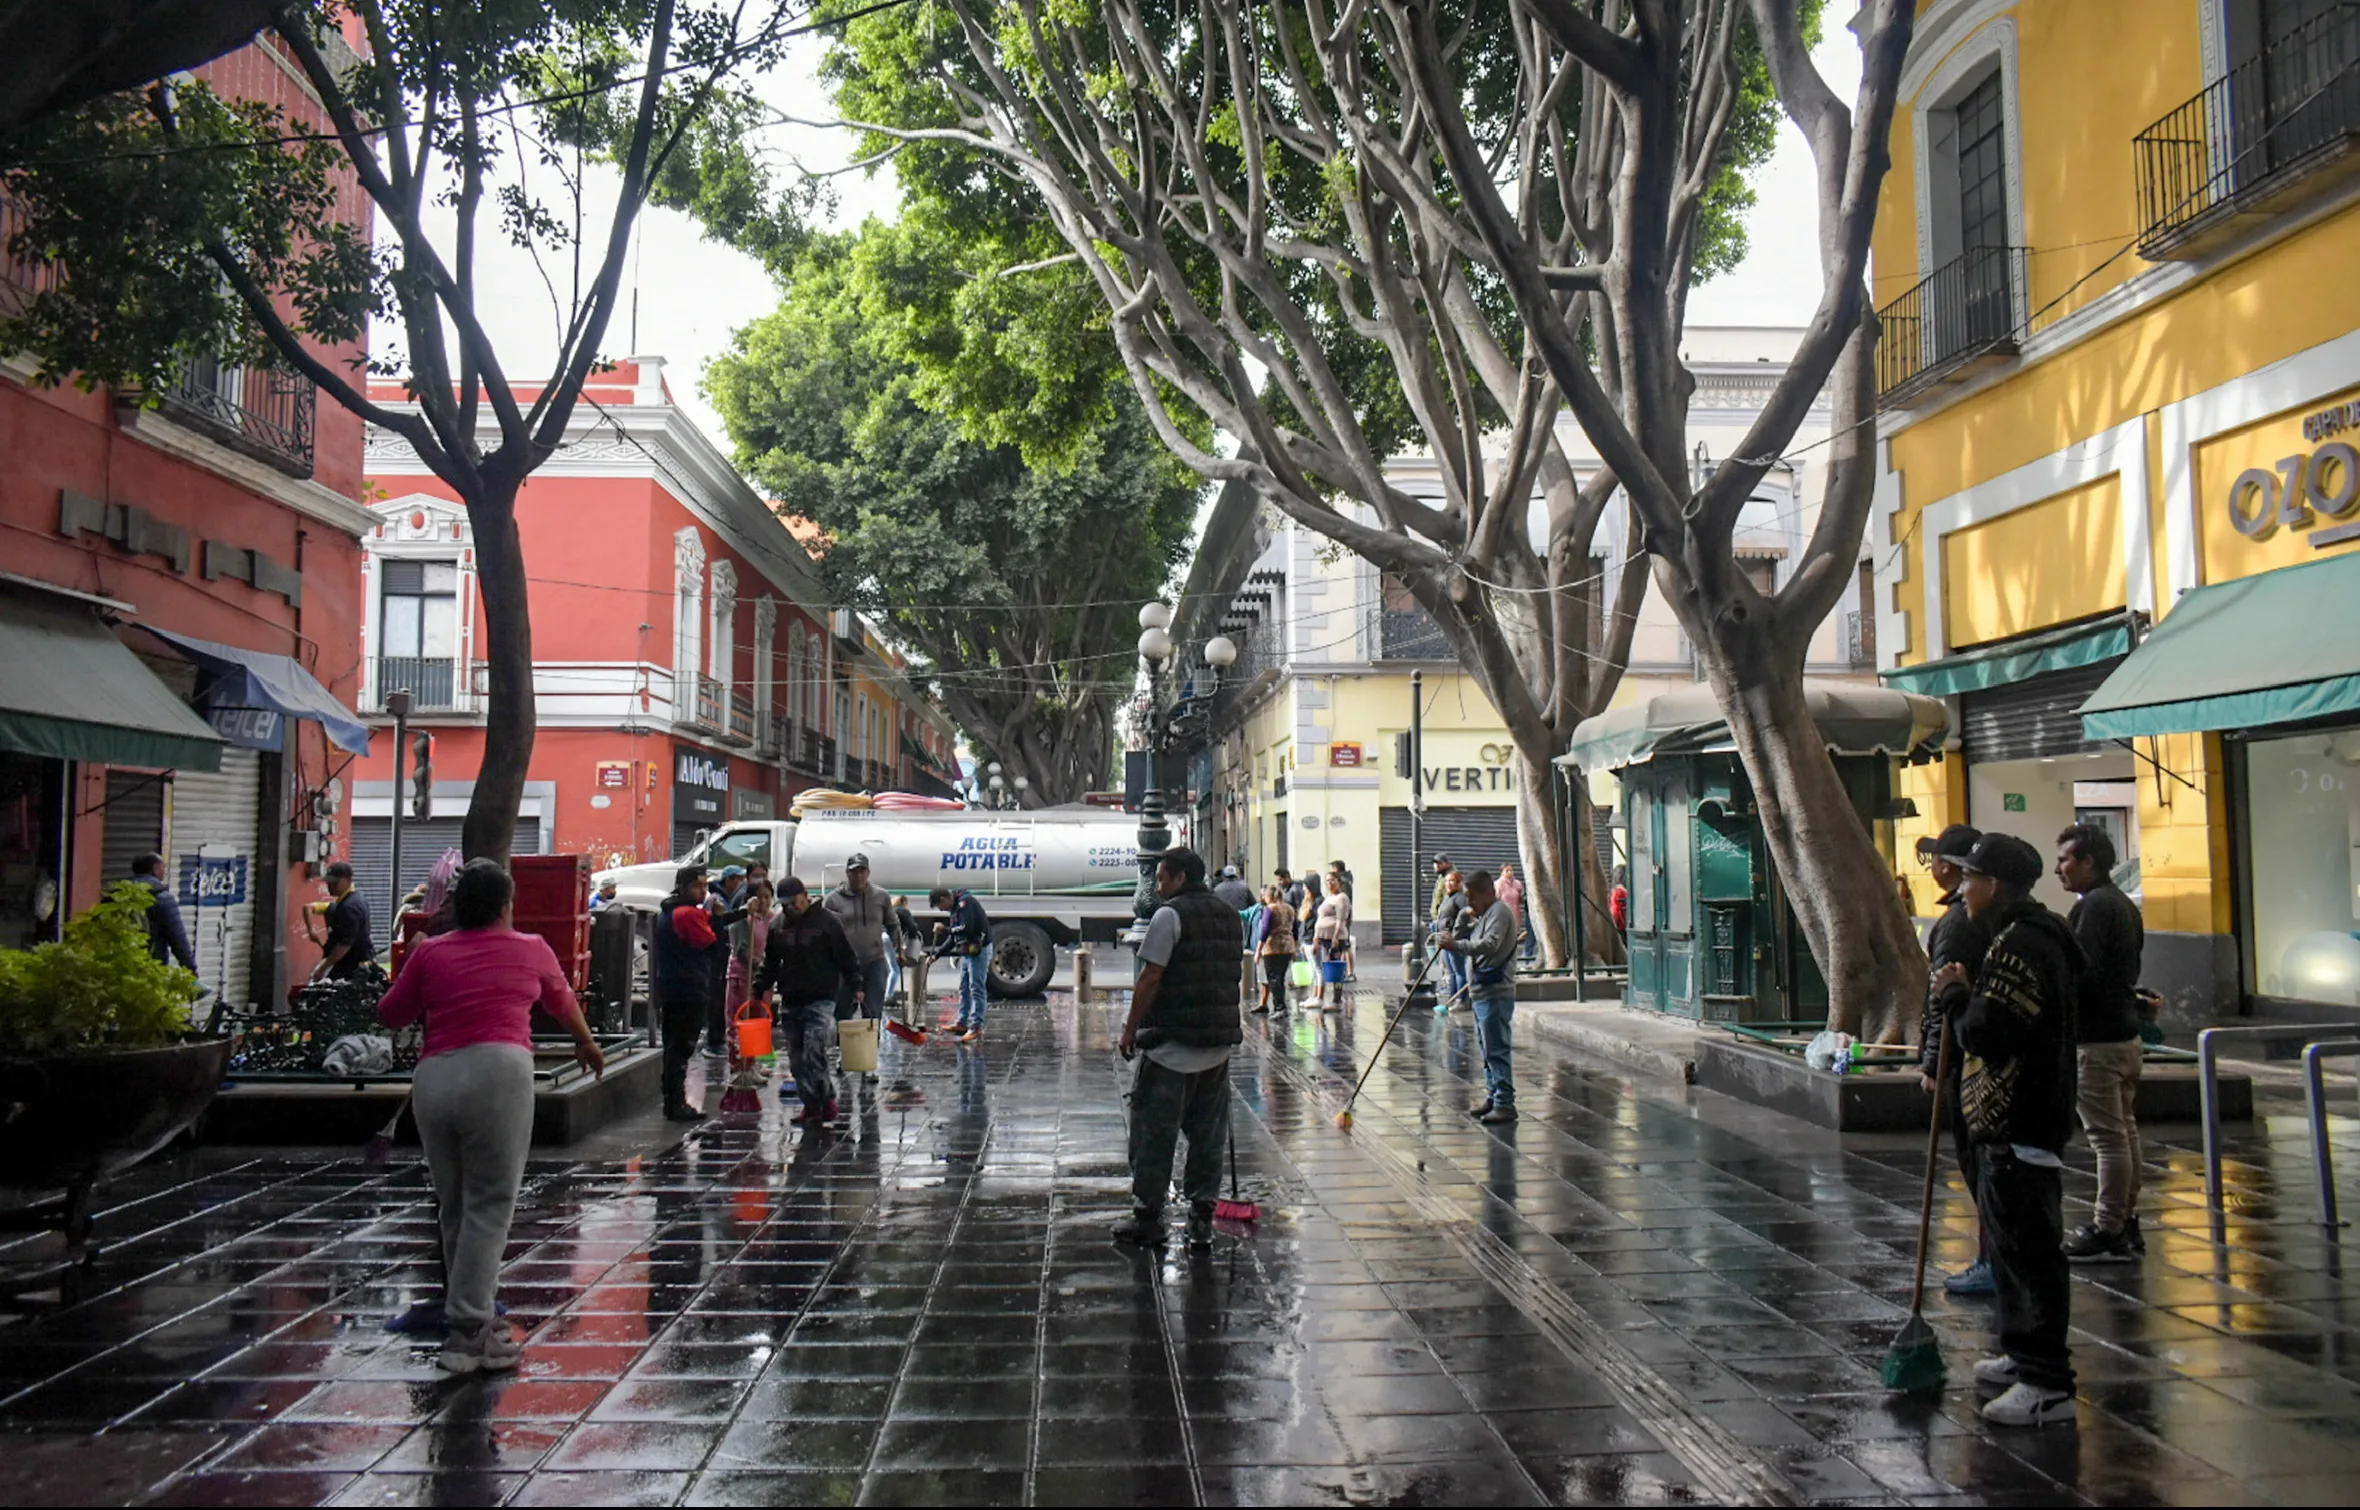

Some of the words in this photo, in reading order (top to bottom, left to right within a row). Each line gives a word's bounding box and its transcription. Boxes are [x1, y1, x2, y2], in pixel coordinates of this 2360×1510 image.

[680, 755, 704, 785] Aldo
[703, 760, 728, 791] Conti
[1422, 767, 1516, 791] VERTI
[959, 837, 1018, 850] AGUA
[941, 852, 1037, 870] POTABLE
